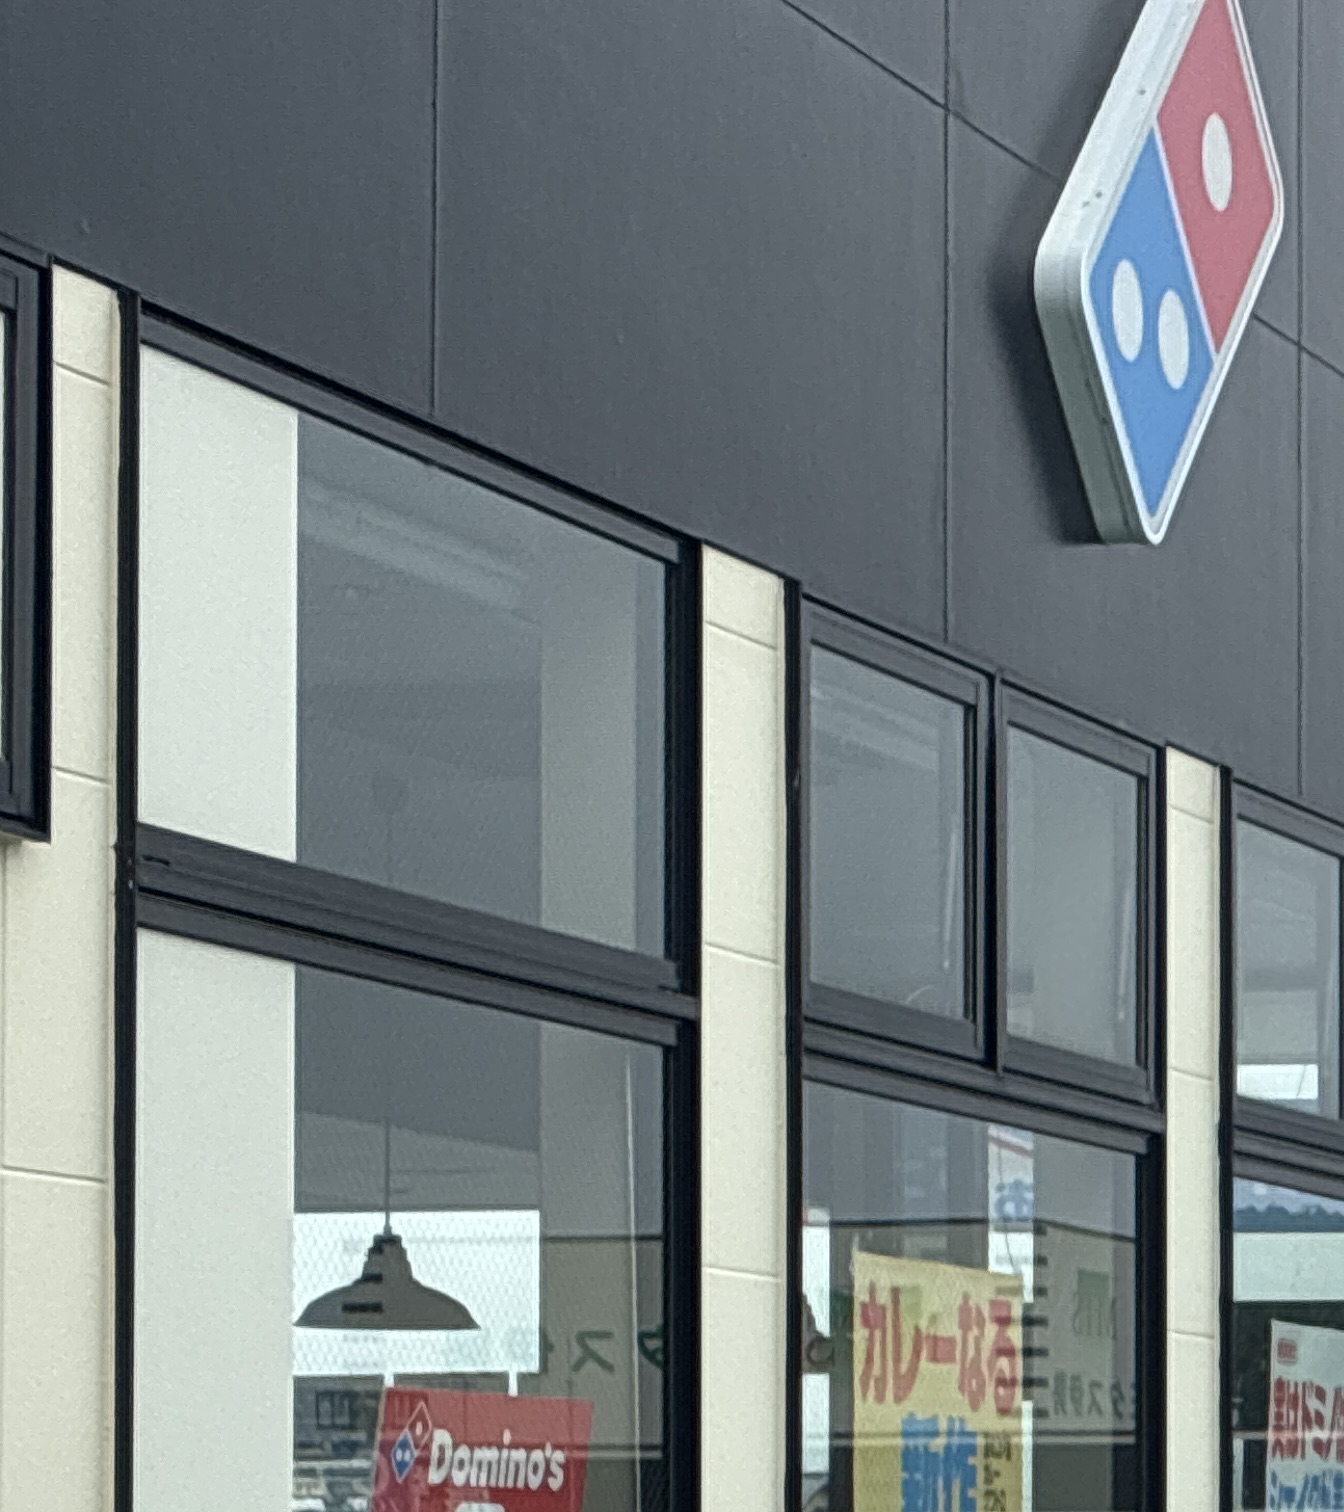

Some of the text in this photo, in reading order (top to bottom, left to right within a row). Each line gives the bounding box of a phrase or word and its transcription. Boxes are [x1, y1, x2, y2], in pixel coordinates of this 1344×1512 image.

[859, 1279, 1017, 1416] カレーなる
[427, 1424, 567, 1493] Domino's
